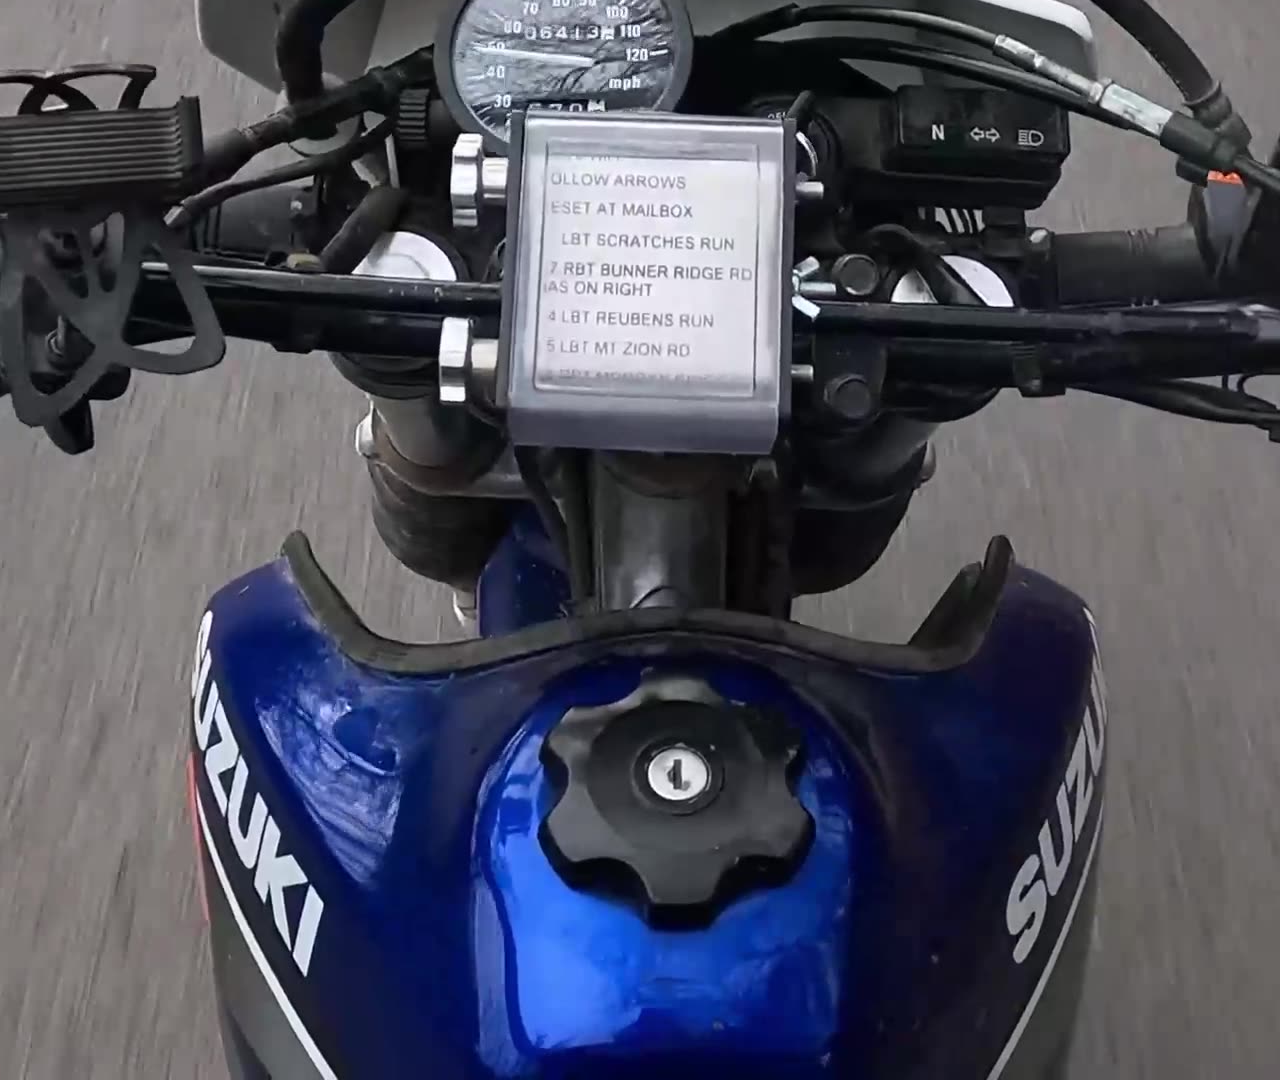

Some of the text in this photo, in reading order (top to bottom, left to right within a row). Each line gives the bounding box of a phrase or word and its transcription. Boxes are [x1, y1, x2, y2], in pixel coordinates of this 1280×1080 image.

[523, 1, 539, 16] 70
[606, 5, 629, 19] 100
[620, 25, 641, 38] 110
[626, 48, 648, 62] 120
[486, 65, 505, 79] 40
[608, 77, 641, 90] mph
[494, 95, 511, 108] 30
[931, 125, 945, 141] N
[551, 172, 686, 190] OLLOW ARROWS
[551, 201, 693, 218] ESET AT MAILBOX
[562, 232, 735, 251] LBT SCRATCHES RUN
[563, 261, 596, 277] RBT
[600, 263, 668, 279] BUNNER
[673, 265, 724, 280] RIDGE
[729, 267, 753, 281] RD
[574, 280, 598, 295] ON
[602, 281, 654, 297] RIGHT
[561, 310, 590, 324] LBT
[596, 311, 674, 327] REUBENS
[679, 314, 715, 328] RUN
[560, 340, 588, 354] LBT
[594, 341, 616, 356] MT
[622, 342, 662, 357] ZION
[667, 343, 691, 357] RD
[1006, 607, 1109, 964] SUZU
